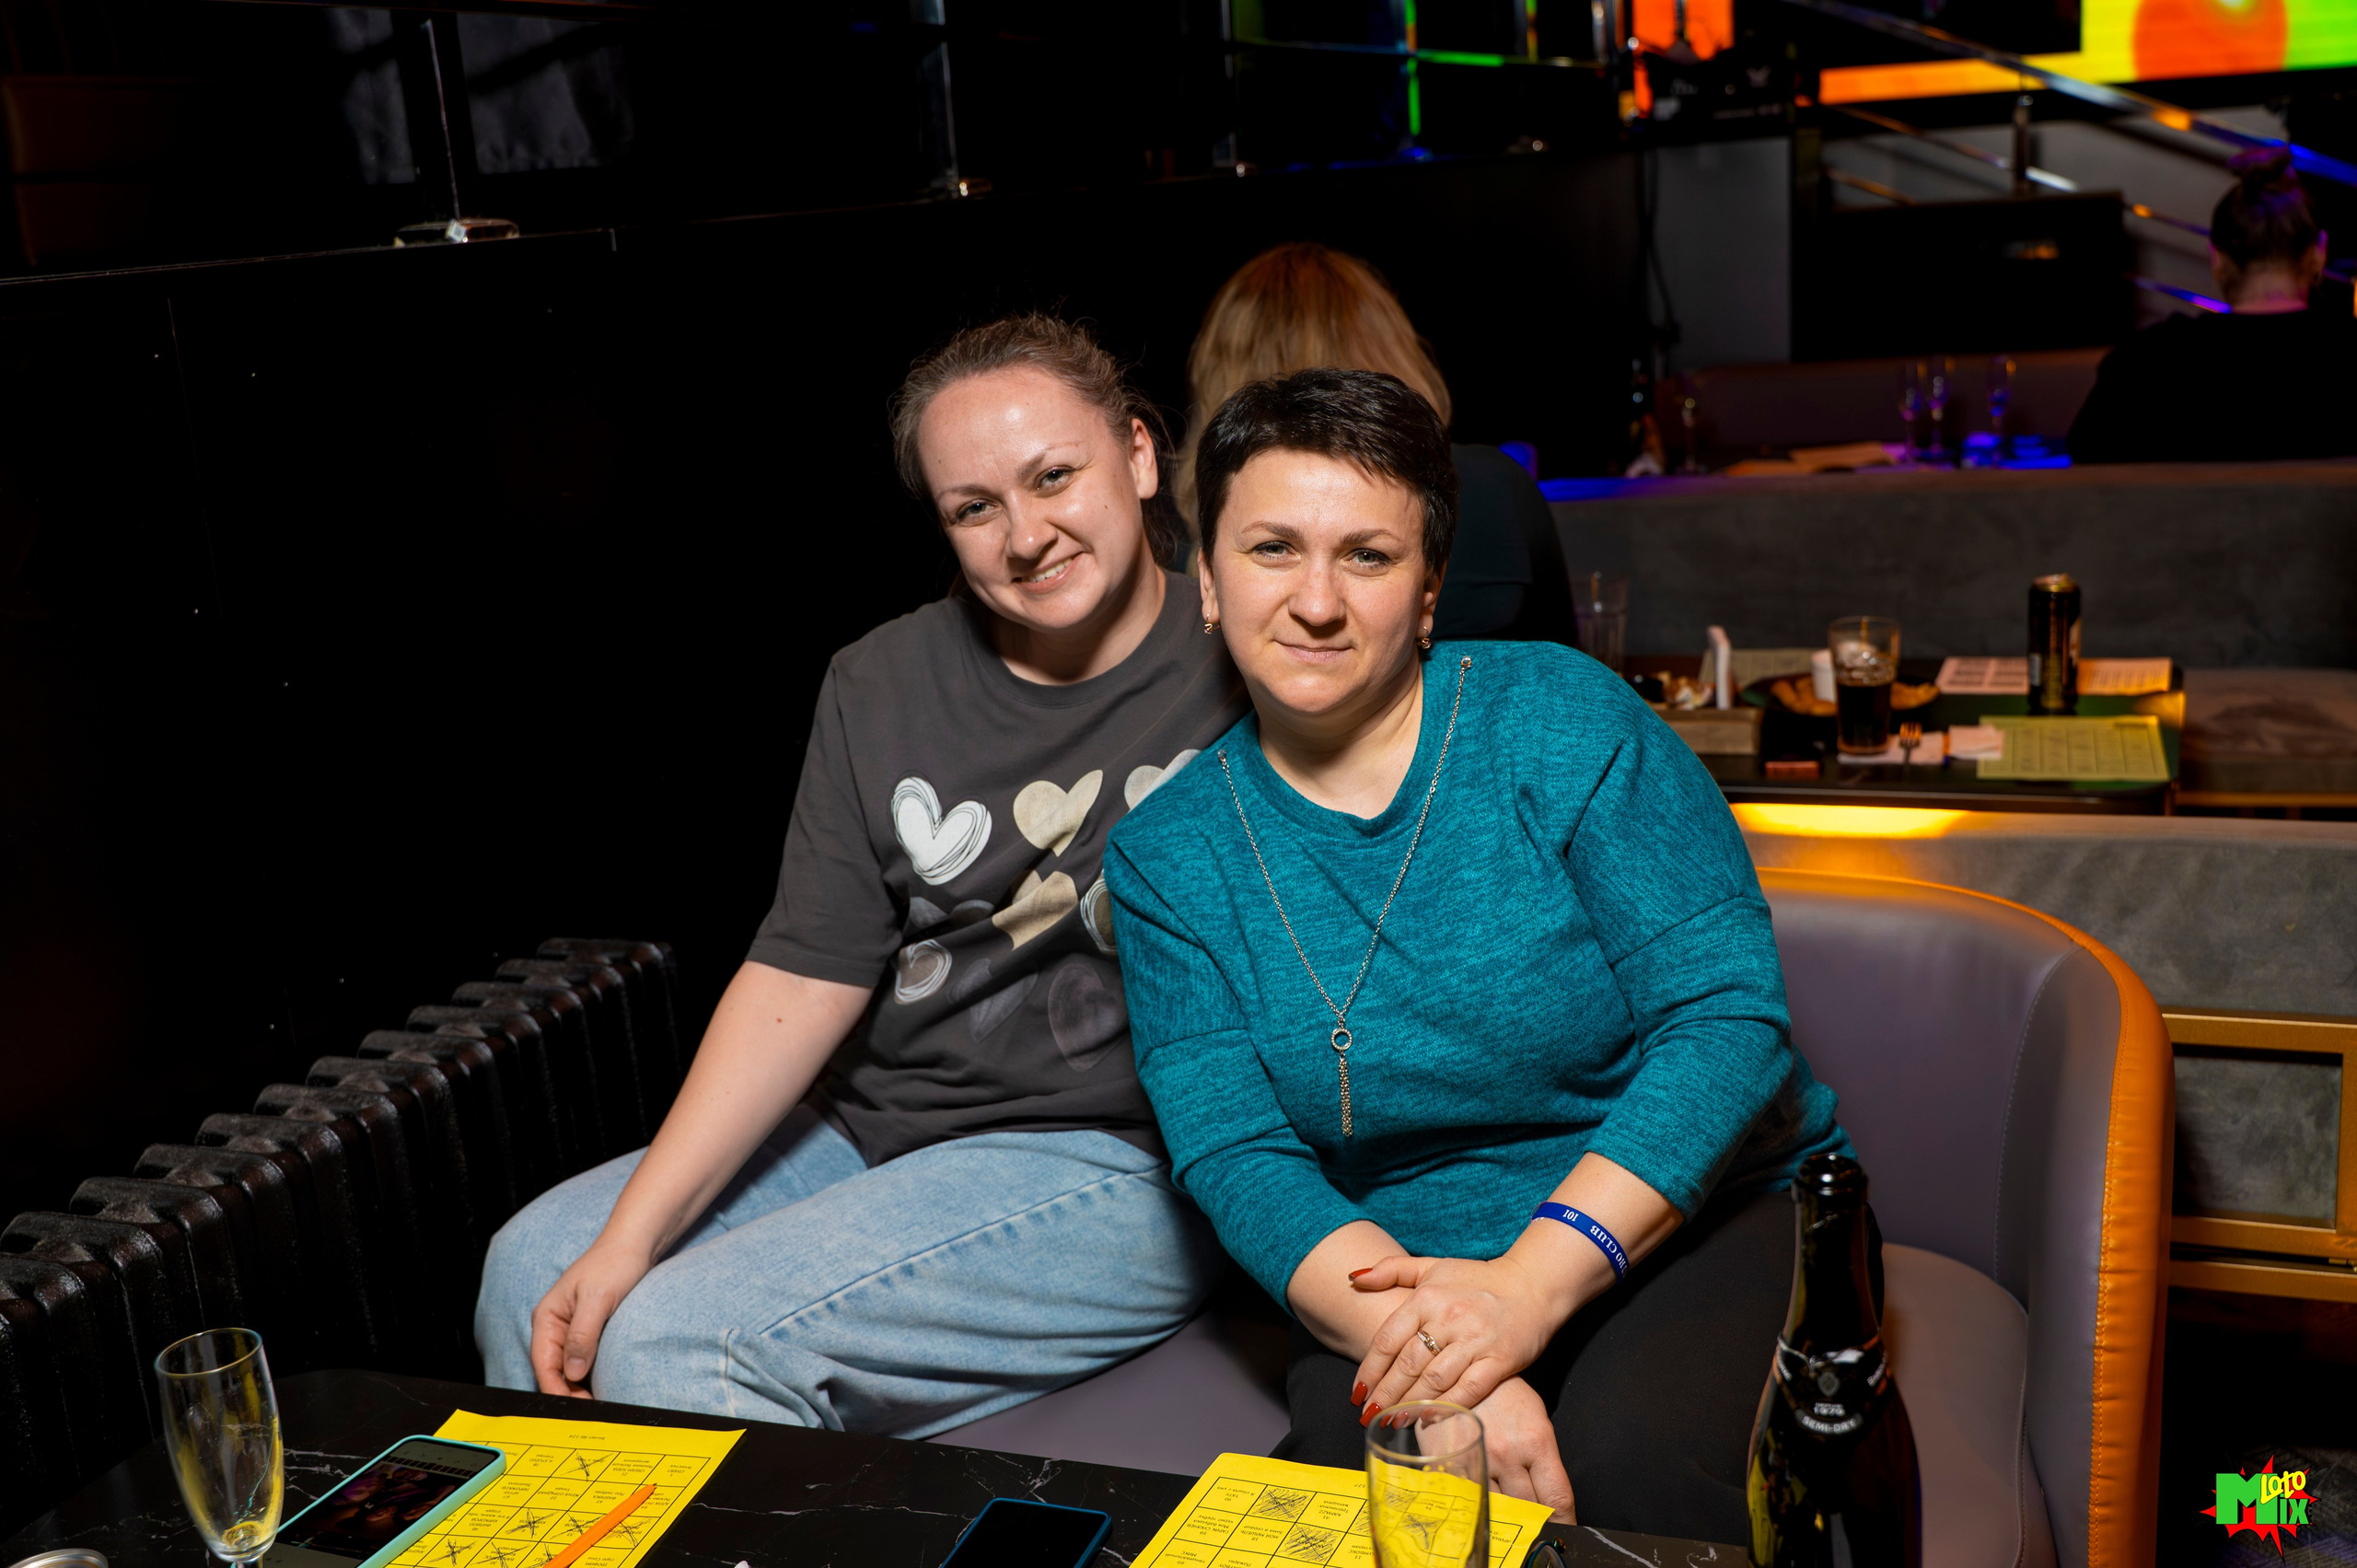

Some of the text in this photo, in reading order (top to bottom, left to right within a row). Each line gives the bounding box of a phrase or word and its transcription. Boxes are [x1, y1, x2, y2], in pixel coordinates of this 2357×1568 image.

[1562, 1209, 1579, 1222] 101
[1590, 1225, 1618, 1254] CLUB
[1801, 1415, 1856, 1434] SEMI-DRY
[1192, 1519, 1218, 1527] бабушка
[1240, 1529, 1266, 1538] МИШЕЛЬ
[1228, 1560, 1252, 1568] Пожары
